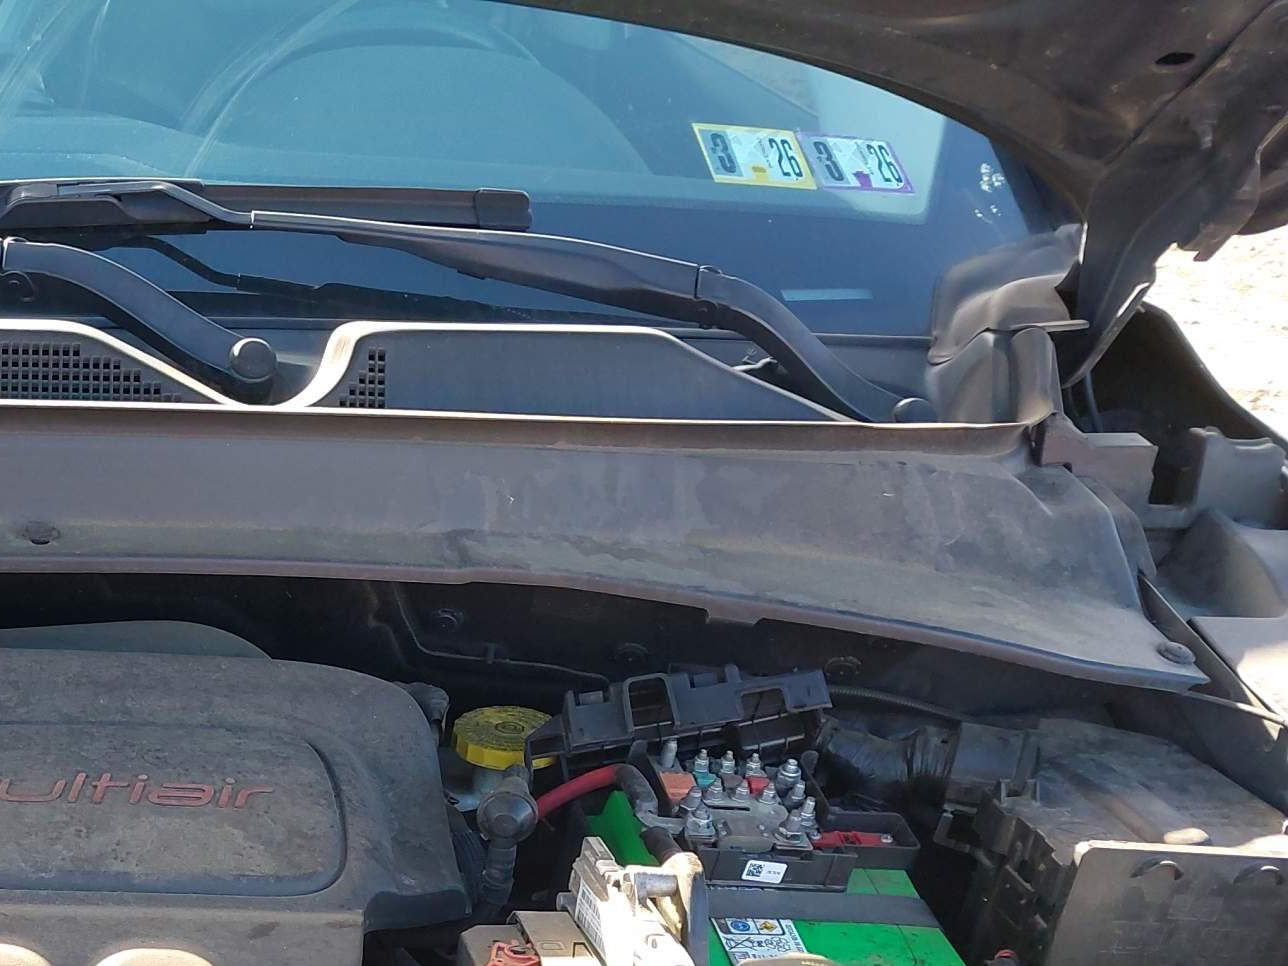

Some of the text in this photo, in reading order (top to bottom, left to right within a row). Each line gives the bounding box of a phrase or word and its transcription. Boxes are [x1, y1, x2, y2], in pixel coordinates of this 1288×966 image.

[710, 133, 737, 173] 3
[768, 137, 803, 178] 26
[813, 141, 844, 181] 3
[866, 144, 903, 183] 26
